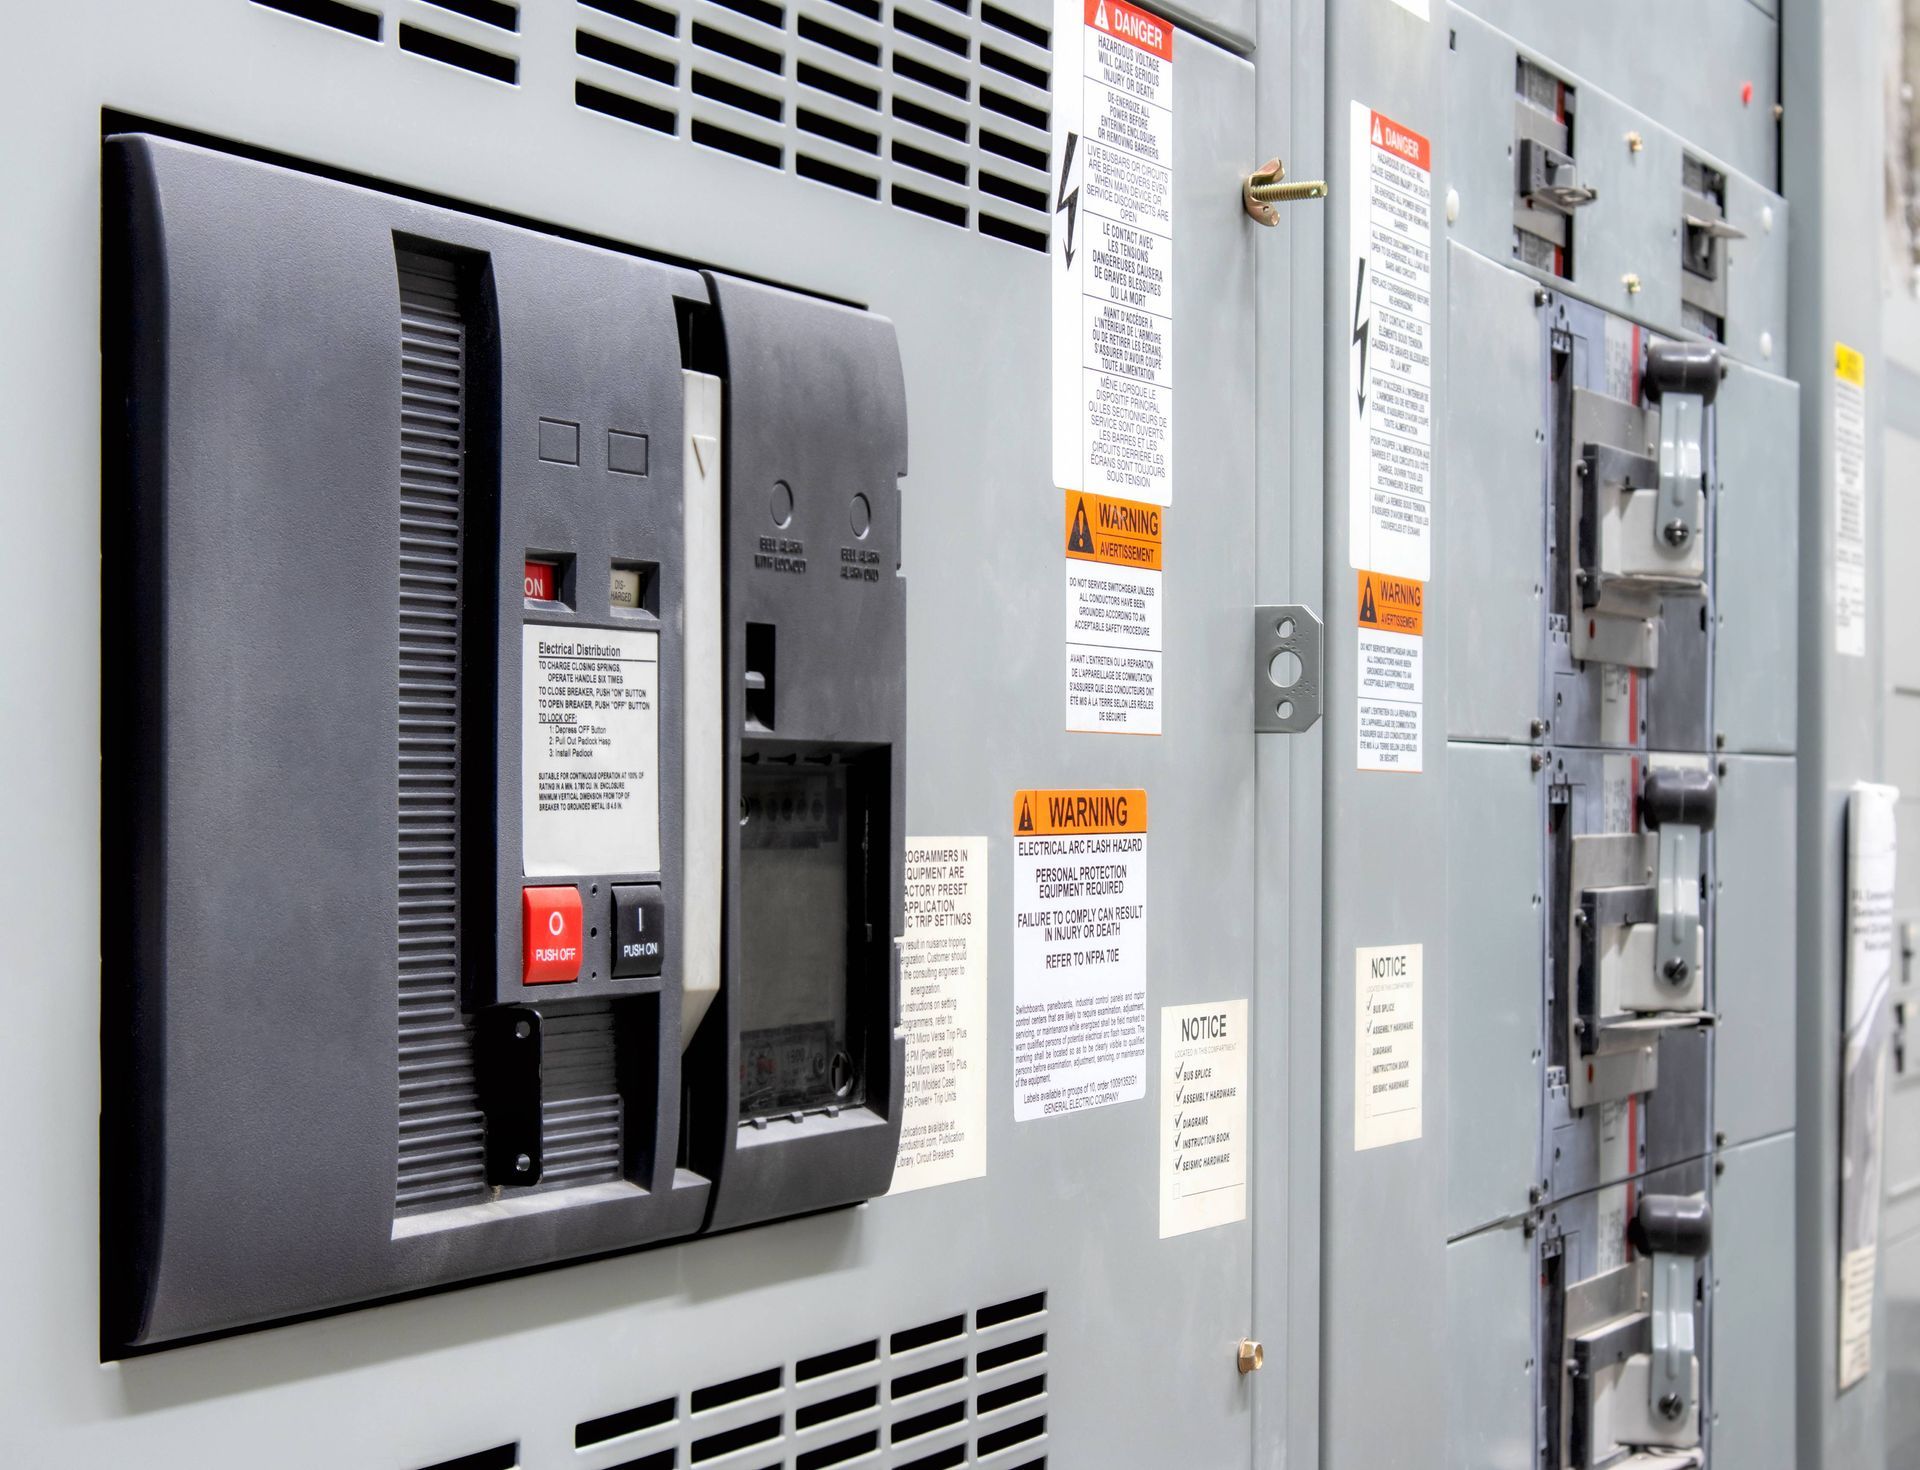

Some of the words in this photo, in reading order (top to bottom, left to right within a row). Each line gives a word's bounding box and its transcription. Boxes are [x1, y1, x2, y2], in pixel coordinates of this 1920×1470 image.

[1115, 9, 1163, 50] DANGER
[1098, 35, 1133, 61] HAZARDOUS
[1135, 49, 1160, 72] VOLTAGE
[1098, 50, 1112, 66] WILL
[1114, 56, 1133, 75] CAUSE
[1134, 64, 1159, 86] SERIOUS
[1104, 68, 1124, 87] INJURY
[1126, 77, 1135, 91] OR
[1136, 80, 1154, 99] DEATH
[1108, 92, 1139, 114] DE-ENERGIZE
[1141, 103, 1150, 118] ALL
[1110, 105, 1128, 123] POWER
[1129, 112, 1148, 130] BEFORE
[1101, 115, 1126, 135] ENTERING
[1127, 124, 1156, 146] ENCLOSURE
[1098, 127, 1106, 140] OR
[1106, 130, 1133, 150] REMOVING
[1134, 140, 1159, 159] BARRIERS
[1385, 127, 1419, 160] DANGER
[1088, 144, 1101, 159] LIVE
[1101, 149, 1130, 170] BUSBARS
[1131, 158, 1141, 173] OR
[1141, 162, 1168, 183] CIRCUITS
[1089, 158, 1101, 173] ARE
[1102, 162, 1125, 181] BEHIND
[1126, 170, 1150, 189] COVERS
[1151, 178, 1167, 195] EVEN
[1095, 174, 1113, 190] WHEN
[1114, 179, 1129, 195] MAIN
[1130, 184, 1151, 202] DEVICE
[1152, 191, 1162, 205] OR
[1087, 184, 1112, 203] SERVICE
[1113, 193, 1156, 217] DISCONNECTS
[1157, 207, 1169, 221] ARE
[1120, 209, 1137, 223] OPEN
[1103, 222, 1110, 236] LE
[1111, 224, 1137, 245] CONTACT
[1139, 233, 1154, 250] AVEC
[1108, 239, 1118, 254] LES
[1120, 243, 1149, 264] TENSIONS
[1093, 250, 1135, 274] DANGEREUSES
[1136, 263, 1163, 282] CAUSERA
[1095, 266, 1102, 280] DE
[1103, 268, 1126, 287] GRAVES
[1128, 275, 1161, 296] BLESSURES
[1111, 286, 1119, 300] OU
[1120, 288, 1128, 302] LA
[1129, 291, 1147, 307] MORT
[1099, 503, 1159, 536] WARNING
[1100, 541, 1155, 563] AVERTISSEMENT
[525, 578, 543, 596] ON
[611, 590, 631, 602] HARGED
[1070, 577, 1076, 587] DO
[1077, 578, 1087, 588] NOT
[1087, 579, 1107, 591] SERVICE
[1108, 581, 1137, 594] SWITCHGEAR
[1137, 585, 1155, 596] UNLESS
[1380, 580, 1421, 607] WARNING
[1079, 592, 1088, 602] ALL
[1089, 593, 1120, 606] CONDUCTORS
[1120, 597, 1132, 607] HAVE
[1133, 598, 1146, 609] BEEN
[1079, 607, 1104, 618] GROUNDED
[1105, 609, 1131, 621] ACCORDING
[1132, 612, 1138, 621] TO
[1139, 613, 1146, 622] AN
[1381, 613, 1418, 629] AVERTISSEMENT
[1074, 621, 1104, 632] ACCEPTABLE
[1105, 624, 1122, 634] SAFETY
[1123, 625, 1150, 636] PROCEDURE
[539, 642, 574, 656] Electrical
[576, 644, 621, 657] Distribution
[539, 661, 546, 670] TO
[547, 661, 570, 671] CHARGE
[571, 662, 595, 672] CLOSING
[548, 674, 573, 683] OPERATE
[574, 674, 596, 684] HANDLE
[598, 675, 606, 684] SIX
[608, 675, 623, 684] TIMES
[539, 686, 546, 695] TO
[547, 687, 565, 696] CLOSE
[596, 688, 610, 697] PUSH
[625, 689, 647, 698] BUTTON
[539, 700, 546, 708] TO
[547, 700, 564, 708] OPEN
[594, 701, 610, 709] PUSH
[628, 701, 650, 710] BUTTON
[539, 713, 546, 722] TO
[547, 714, 563, 722] LOCK
[1049, 796, 1128, 827] WARNING
[960, 850, 968, 862] IN
[1019, 841, 1066, 856] ELECTRICAL
[1068, 840, 1085, 854] ARC
[1086, 839, 1111, 853] FLASH
[1112, 838, 1142, 852] HAZARD
[905, 867, 946, 881] QUIPMENT
[948, 866, 965, 879] ARE
[1036, 867, 1077, 882] PERSONAL
[1079, 865, 1127, 880] PROTECTION
[904, 884, 936, 897] ACTORY
[937, 883, 968, 895] PRESET
[1039, 883, 1084, 898] EQUIPMENT
[1085, 881, 1124, 896] REQUIRED
[916, 914, 932, 927] TRIP
[934, 912, 972, 926] SETTINGS
[1018, 912, 1050, 927] FAILURE
[1053, 911, 1063, 925] TO
[1065, 909, 1096, 924] COMPLY
[1097, 907, 1113, 922] CAN
[1115, 905, 1144, 920] RESULT
[1045, 928, 1052, 941] IN
[1054, 925, 1081, 941] INJURY
[1083, 924, 1095, 938] OR
[1096, 922, 1120, 937] DEATH
[536, 948, 558, 960] PUSH
[559, 948, 576, 960] OFF
[624, 944, 644, 957] PUSH
[645, 943, 657, 955] ON
[1046, 953, 1072, 969] REFER
[1074, 952, 1084, 966] TO
[1085, 950, 1105, 965] NFPA
[1107, 949, 1120, 963] 70E
[1372, 956, 1406, 979] NOTICE
[1182, 1015, 1227, 1042] NOTICE
[1184, 1070, 1193, 1081] BUS
[1194, 1068, 1212, 1079] SPLICE
[1183, 1091, 1209, 1104] ASSEMBLY
[1209, 1087, 1236, 1100] HARDWARE
[1183, 1116, 1209, 1129] DIAGRAMS
[1183, 1134, 1215, 1149] INSTRUCTION
[1216, 1132, 1231, 1143] BOOK
[1183, 1158, 1202, 1171] SEISMIC
[1203, 1153, 1230, 1168] HARDWARE
